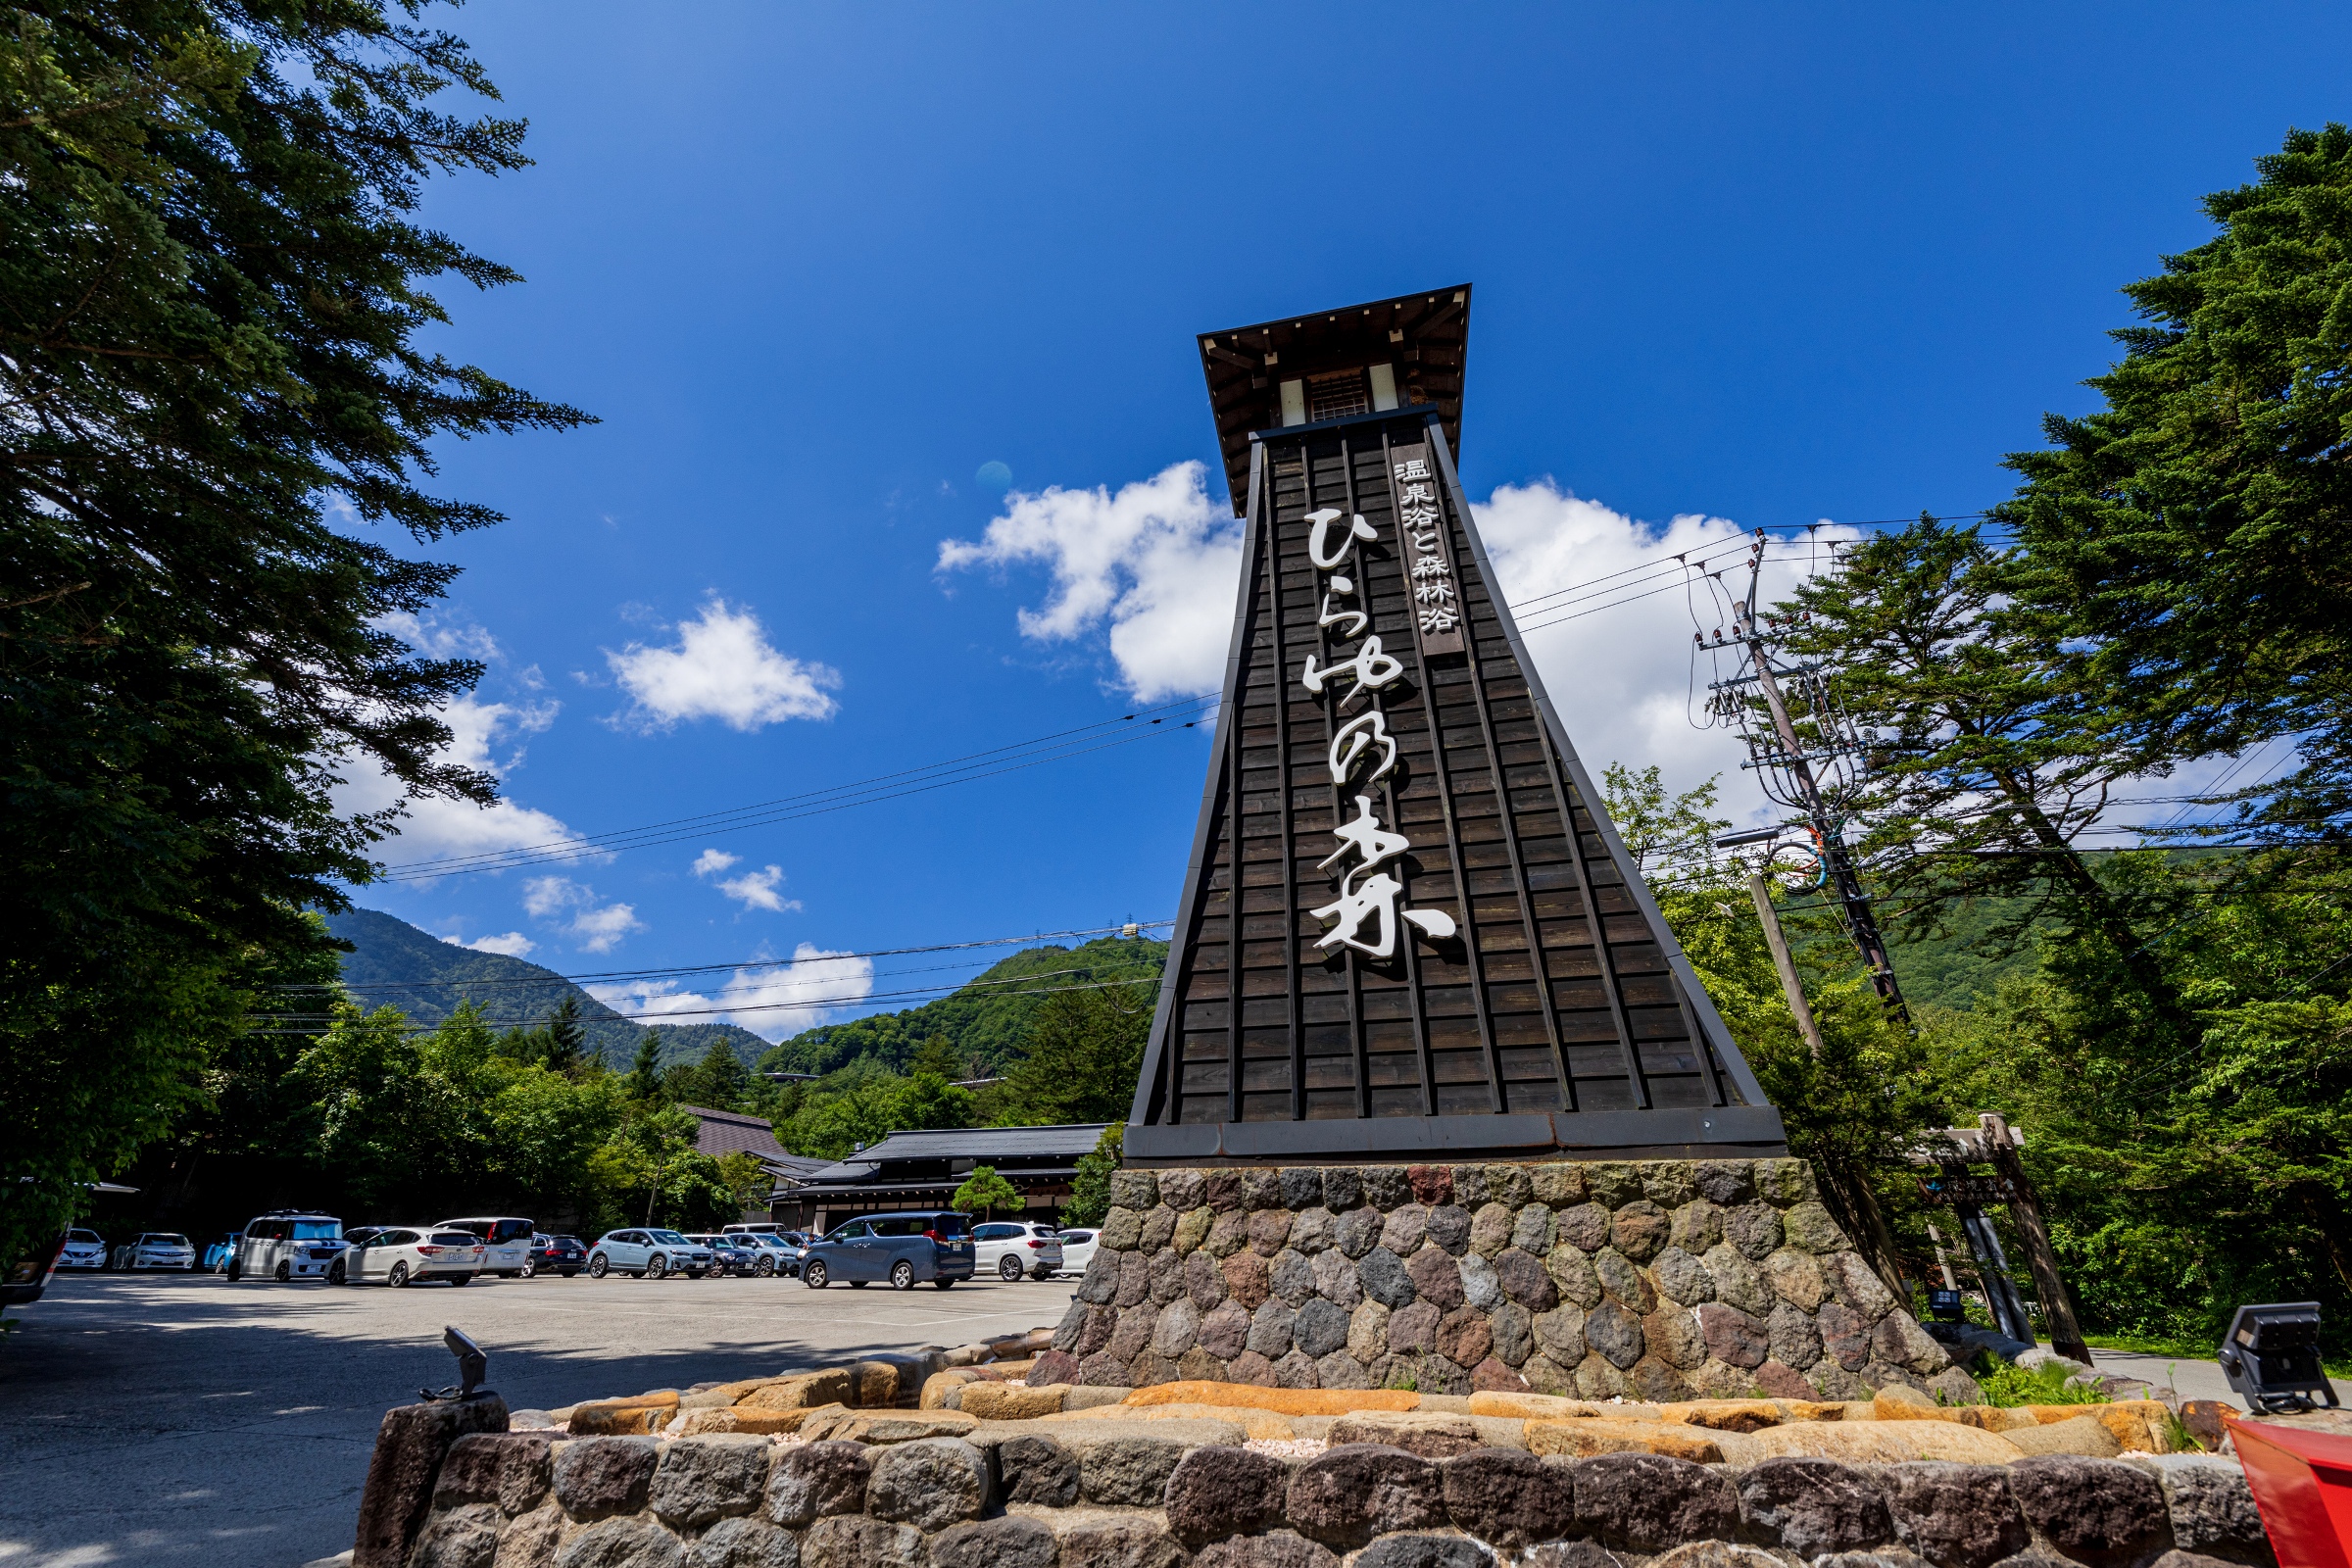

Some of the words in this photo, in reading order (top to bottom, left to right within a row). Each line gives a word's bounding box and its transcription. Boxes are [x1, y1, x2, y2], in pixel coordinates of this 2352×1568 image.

[1395, 459, 1459, 633] 温泉浴と森林浴
[1302, 508, 1456, 958] ひらゆの森
